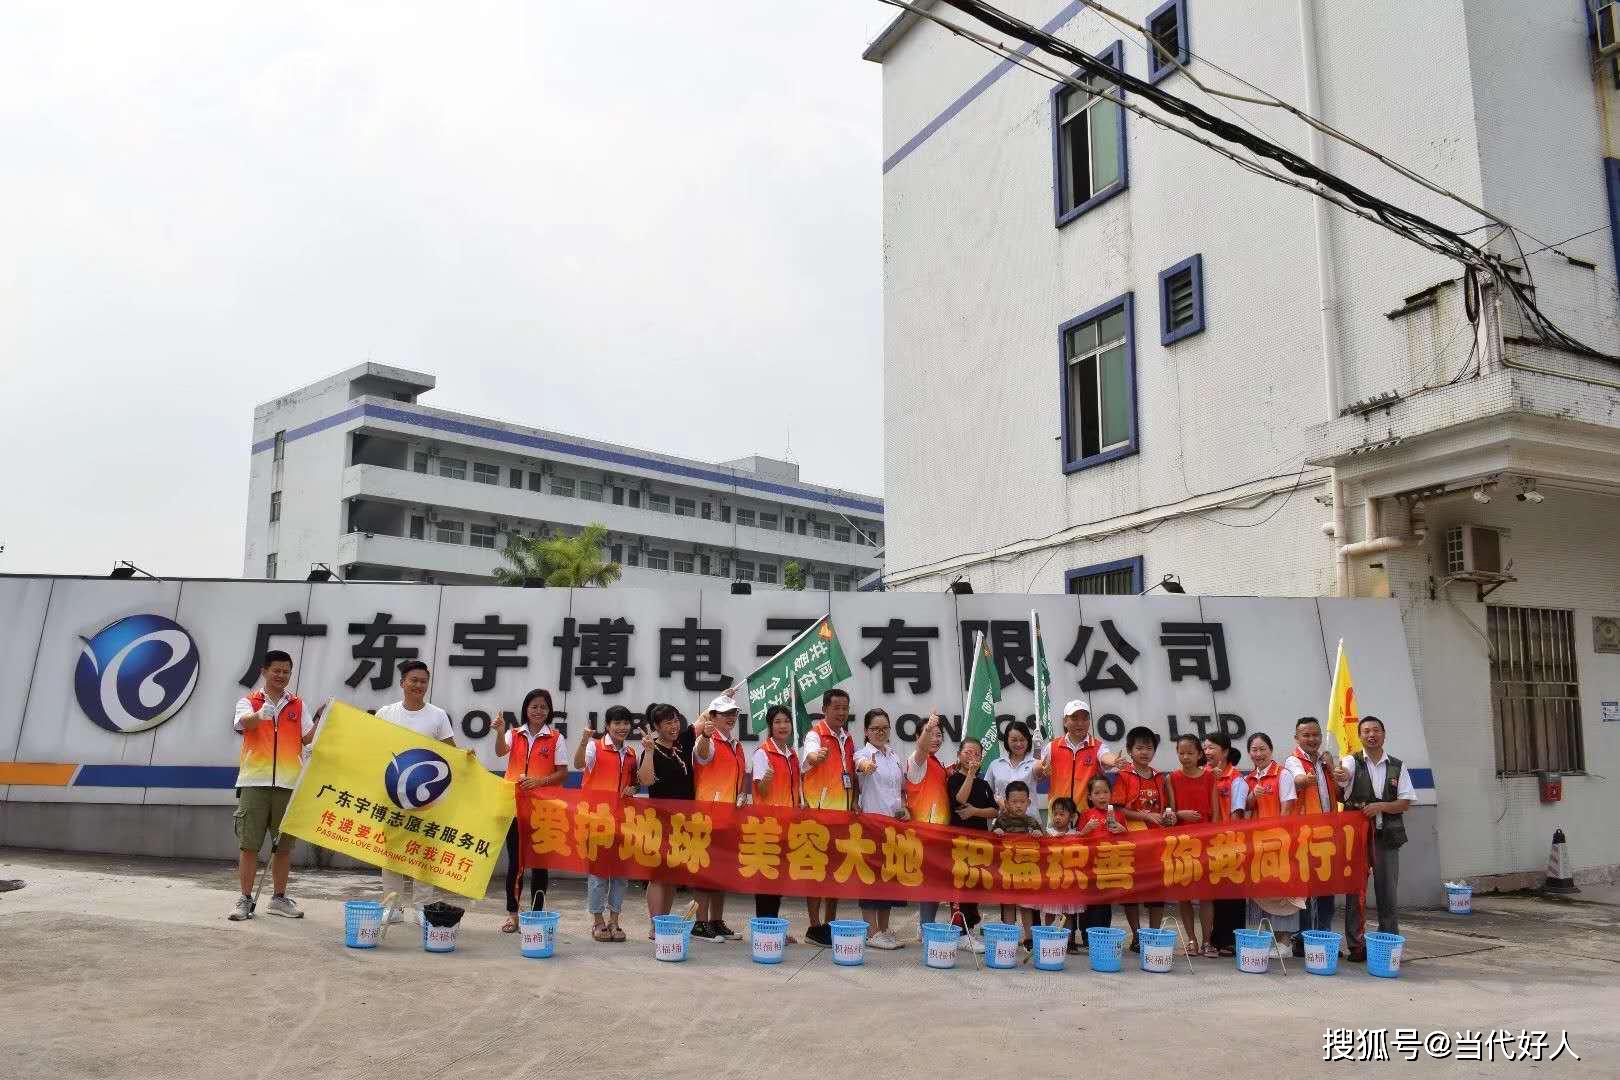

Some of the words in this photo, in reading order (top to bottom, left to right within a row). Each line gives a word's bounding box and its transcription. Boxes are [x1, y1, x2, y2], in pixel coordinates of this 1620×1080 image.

[315, 825, 350, 844] PASSING
[350, 837, 371, 851] LOVE
[372, 845, 407, 864] SHARING
[428, 863, 446, 876] YOU
[446, 868, 463, 882] AND
[316, 783, 490, 858] 广东宇博志愿者服务队
[320, 808, 387, 845] 传递爱心
[404, 839, 474, 874] 你我同行
[529, 798, 713, 875] 爱护地球
[736, 814, 926, 888] 美容大地
[951, 834, 1137, 891] 积福积善
